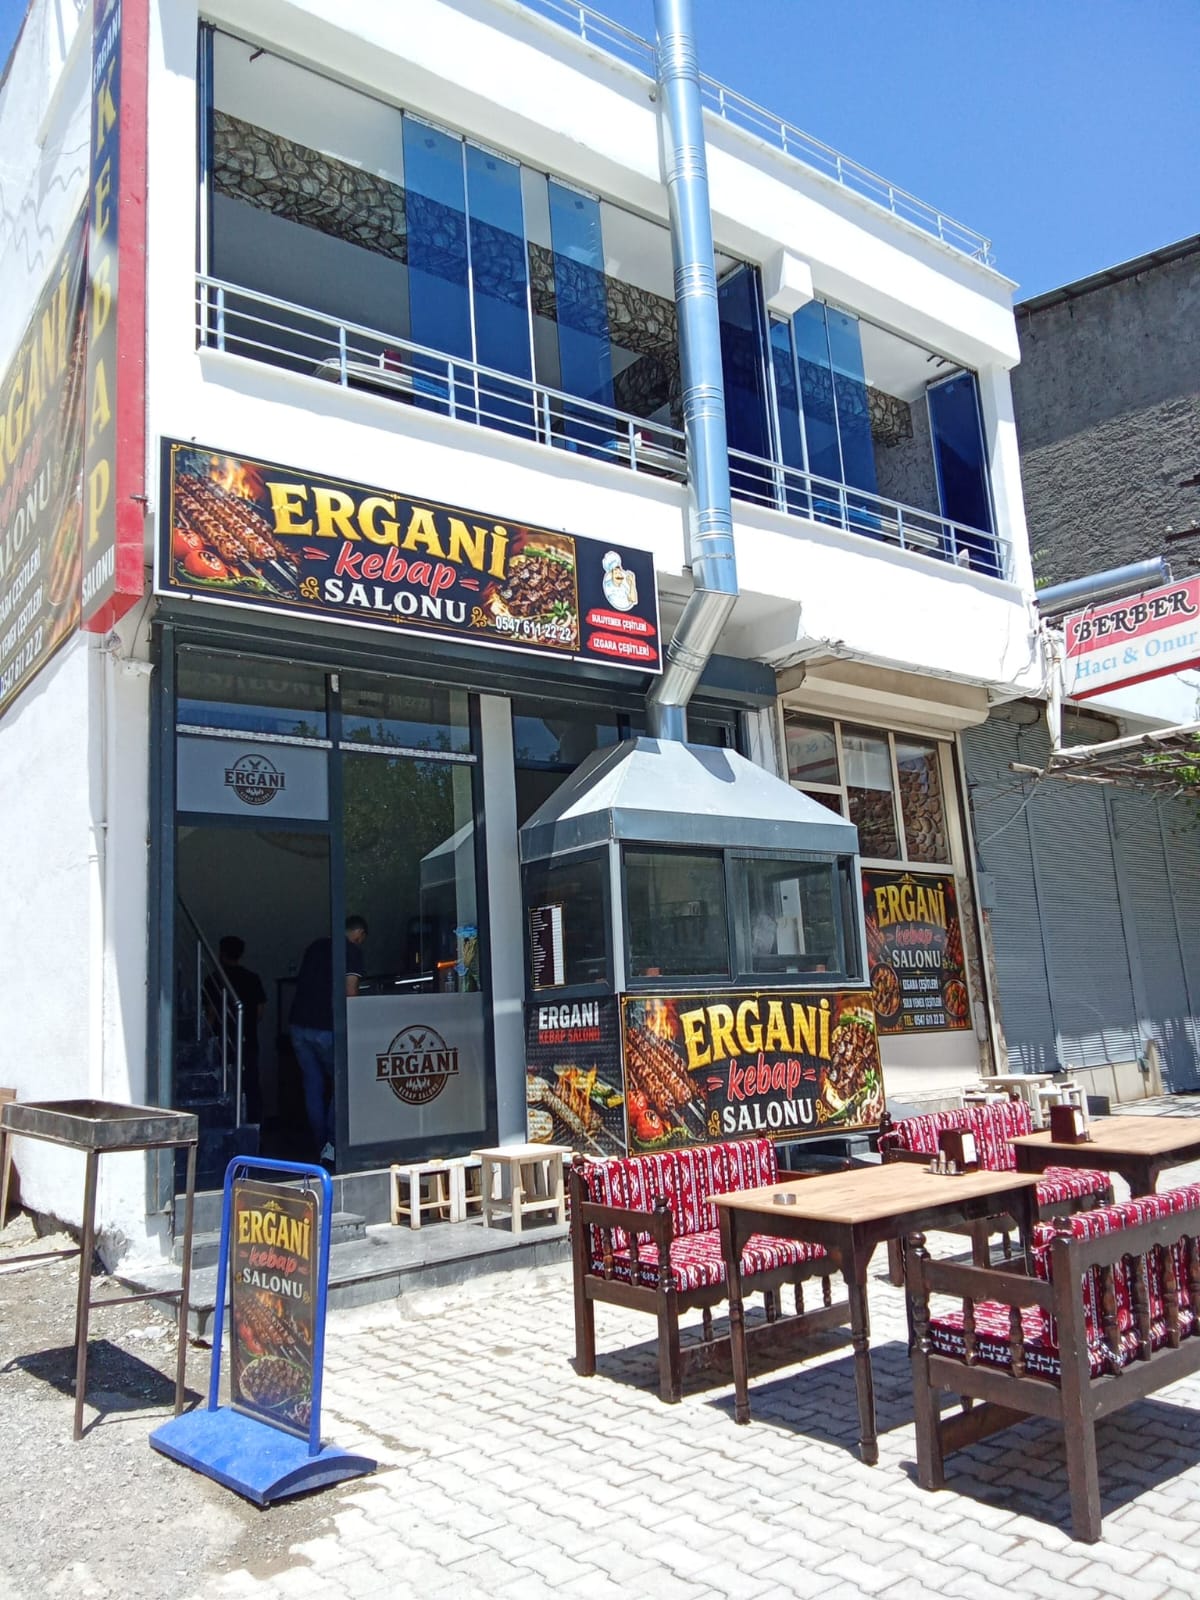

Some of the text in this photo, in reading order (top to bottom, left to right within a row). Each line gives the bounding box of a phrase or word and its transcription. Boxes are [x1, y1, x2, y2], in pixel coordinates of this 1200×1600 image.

[265, 481, 509, 581] ERGANİ
[82, 544, 115, 608] SALONU
[334, 541, 457, 597] kebap
[324, 579, 467, 624] SALONU
[1073, 590, 1197, 642] BERBER
[495, 616, 572, 641] 0547 611 22 22
[1122, 646, 1138, 665] &
[1144, 631, 1198, 657] Onur
[224, 770, 286, 788] ERGANİ
[873, 882, 948, 930] ERGANİ
[894, 924, 933, 947] kebap
[892, 950, 941, 969] SALONU
[538, 1001, 600, 1030] ERGANİ
[538, 1029, 566, 1044] KEBAP
[680, 998, 832, 1072] ERGANİ
[377, 1048, 459, 1078] ERGANİ
[727, 1052, 800, 1101] kebap
[722, 1098, 814, 1133] SALONU
[238, 1210, 311, 1260] ERGANİ
[249, 1247, 298, 1276] kebap
[242, 1267, 304, 1299] SALONU
